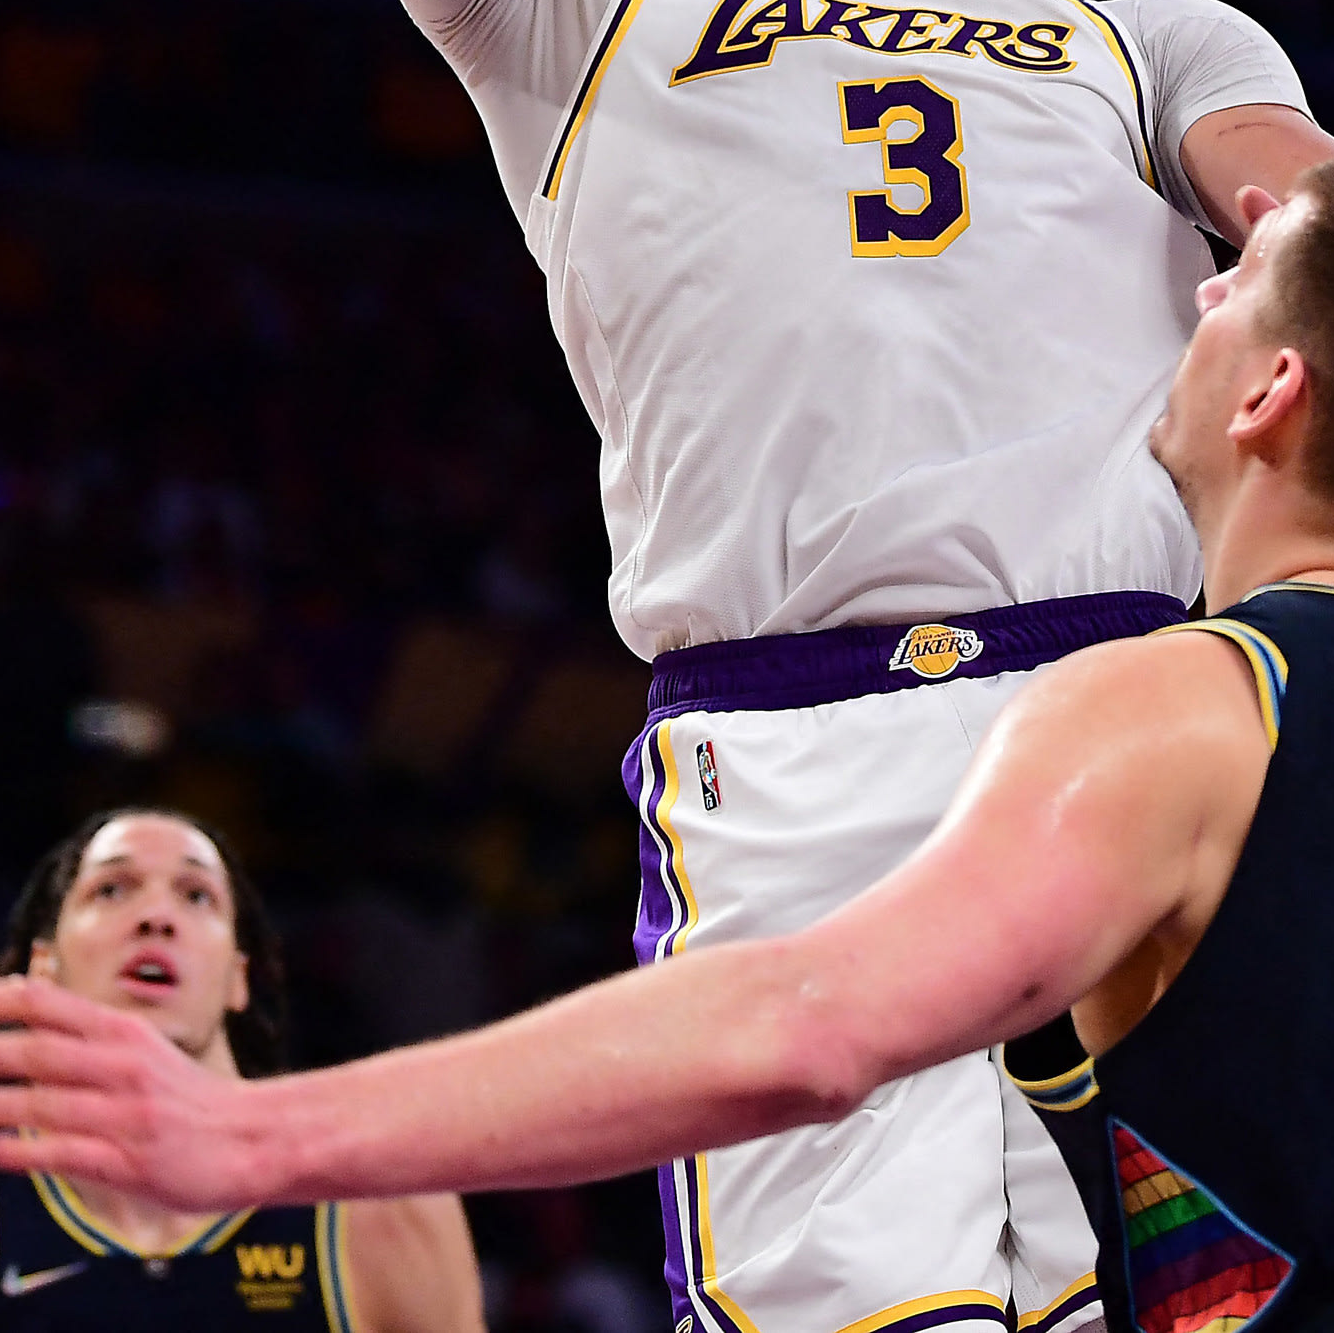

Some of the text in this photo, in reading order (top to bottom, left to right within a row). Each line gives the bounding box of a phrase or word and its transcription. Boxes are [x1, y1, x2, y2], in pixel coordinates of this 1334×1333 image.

[836, 75, 971, 258] 3
[891, 636, 980, 665] LAKERS
[235, 1243, 305, 1278] WU
